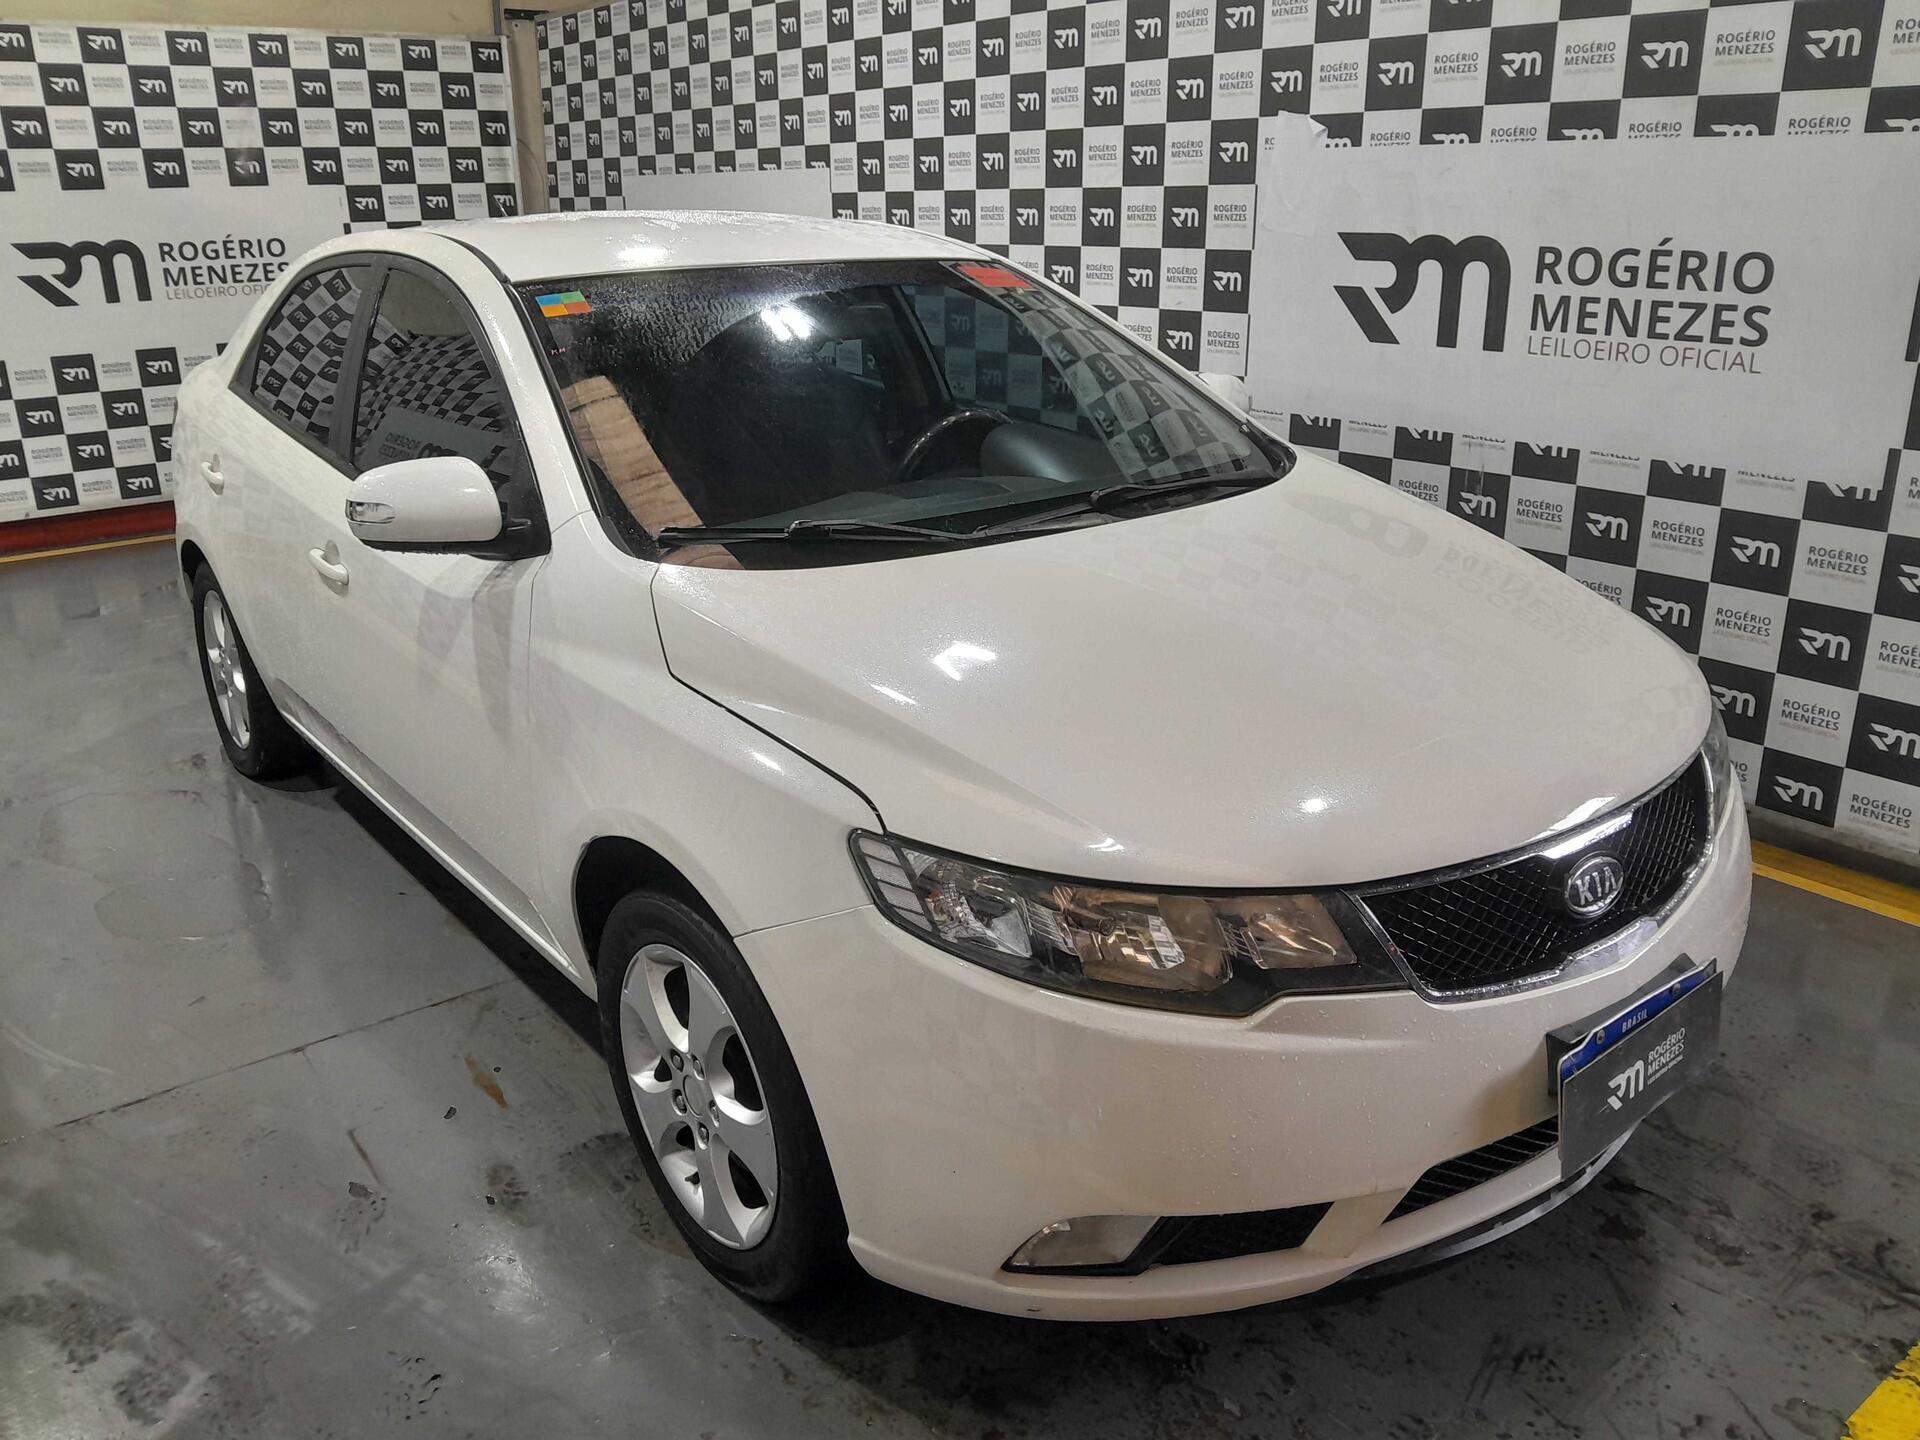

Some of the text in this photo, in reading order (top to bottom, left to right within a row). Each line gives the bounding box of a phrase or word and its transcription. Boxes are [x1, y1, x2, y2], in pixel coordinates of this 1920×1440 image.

[1271, 5, 1308, 17] MENEZES
[1176, 17, 1208, 29] MENEZES
[1717, 27, 1777, 43] ROGÉRIO
[1565, 40, 1616, 55] ROGÉRIO
[1715, 42, 1775, 56] MENEZES
[1434, 51, 1479, 65] ROGÉRIO
[1564, 54, 1615, 66] MENEZES
[1320, 61, 1358, 74] ROGÉRIO
[1433, 63, 1478, 75] MENEZES
[1219, 80, 1253, 91] MENEZES
[1319, 72, 1358, 84] MENEZES
[1628, 120, 1682, 134] ROGÉRIO
[1787, 115, 1851, 130] ROGÉRIO
[1370, 130, 1410, 142] ROGÉRIO
[1490, 125, 1537, 138] ROGÉRIO
[1171, 150, 1203, 158] MENEZES
[1213, 214, 1246, 222] MENEZES
[158, 234, 286, 262] ROGÉRIO
[1535, 237, 1775, 294] ROGÉRIO
[1166, 276, 1197, 284] MENEZES
[166, 285, 238, 300] LEILOEIRO
[1529, 294, 1772, 347] MENEZES
[1207, 339, 1239, 349] MENEZES
[1527, 335, 1762, 374] LEILOEIRO OFICIAL
[1517, 498, 1563, 513] ROGÉRIO
[1516, 508, 1562, 523] MENEZES
[1652, 520, 1705, 537] ROGÉRIO
[1651, 530, 1704, 548] MENEZES
[1808, 545, 1869, 565] ROGÉRIO
[1806, 557, 1867, 576] MENEZES
[1576, 579, 1622, 596] OGÉRIO
[1716, 607, 1772, 627] ROGÉRIO
[1714, 618, 1770, 638] MENEZES
[1782, 698, 1841, 721] ROGÉRIO
[1780, 709, 1839, 731] MENEZES
[1851, 794, 1914, 819] ROGÉRIO
[1849, 804, 1912, 830] MENEZES
[1575, 866, 1617, 906] KIA
[1622, 1009, 1648, 1033] BRASIL
[1648, 1027, 1686, 1063] ROGÉRIO
[1647, 1040, 1685, 1076] MENEZES
